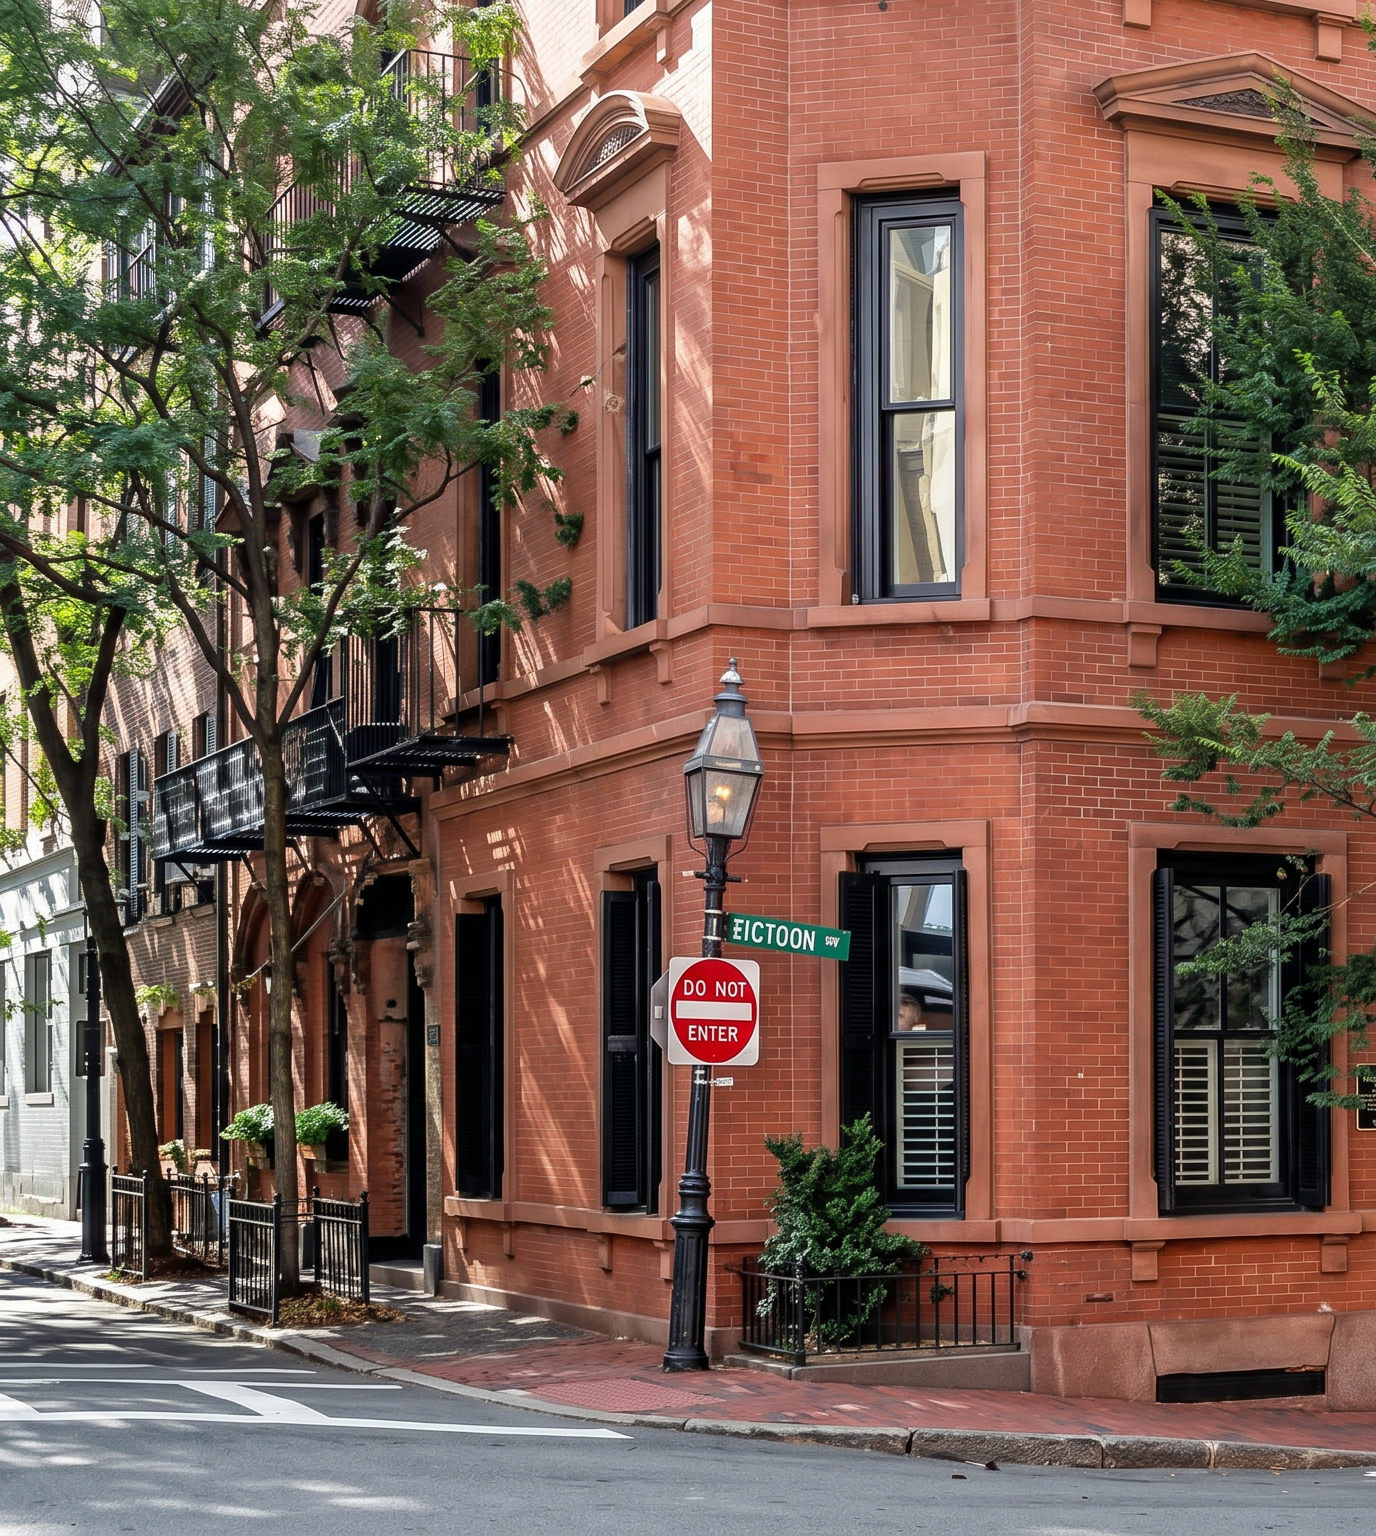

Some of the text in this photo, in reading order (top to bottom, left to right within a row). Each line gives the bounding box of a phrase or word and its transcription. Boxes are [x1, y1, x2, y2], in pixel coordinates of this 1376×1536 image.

[683, 979, 747, 998] DO NOT
[688, 1025, 738, 1042] ENTER
